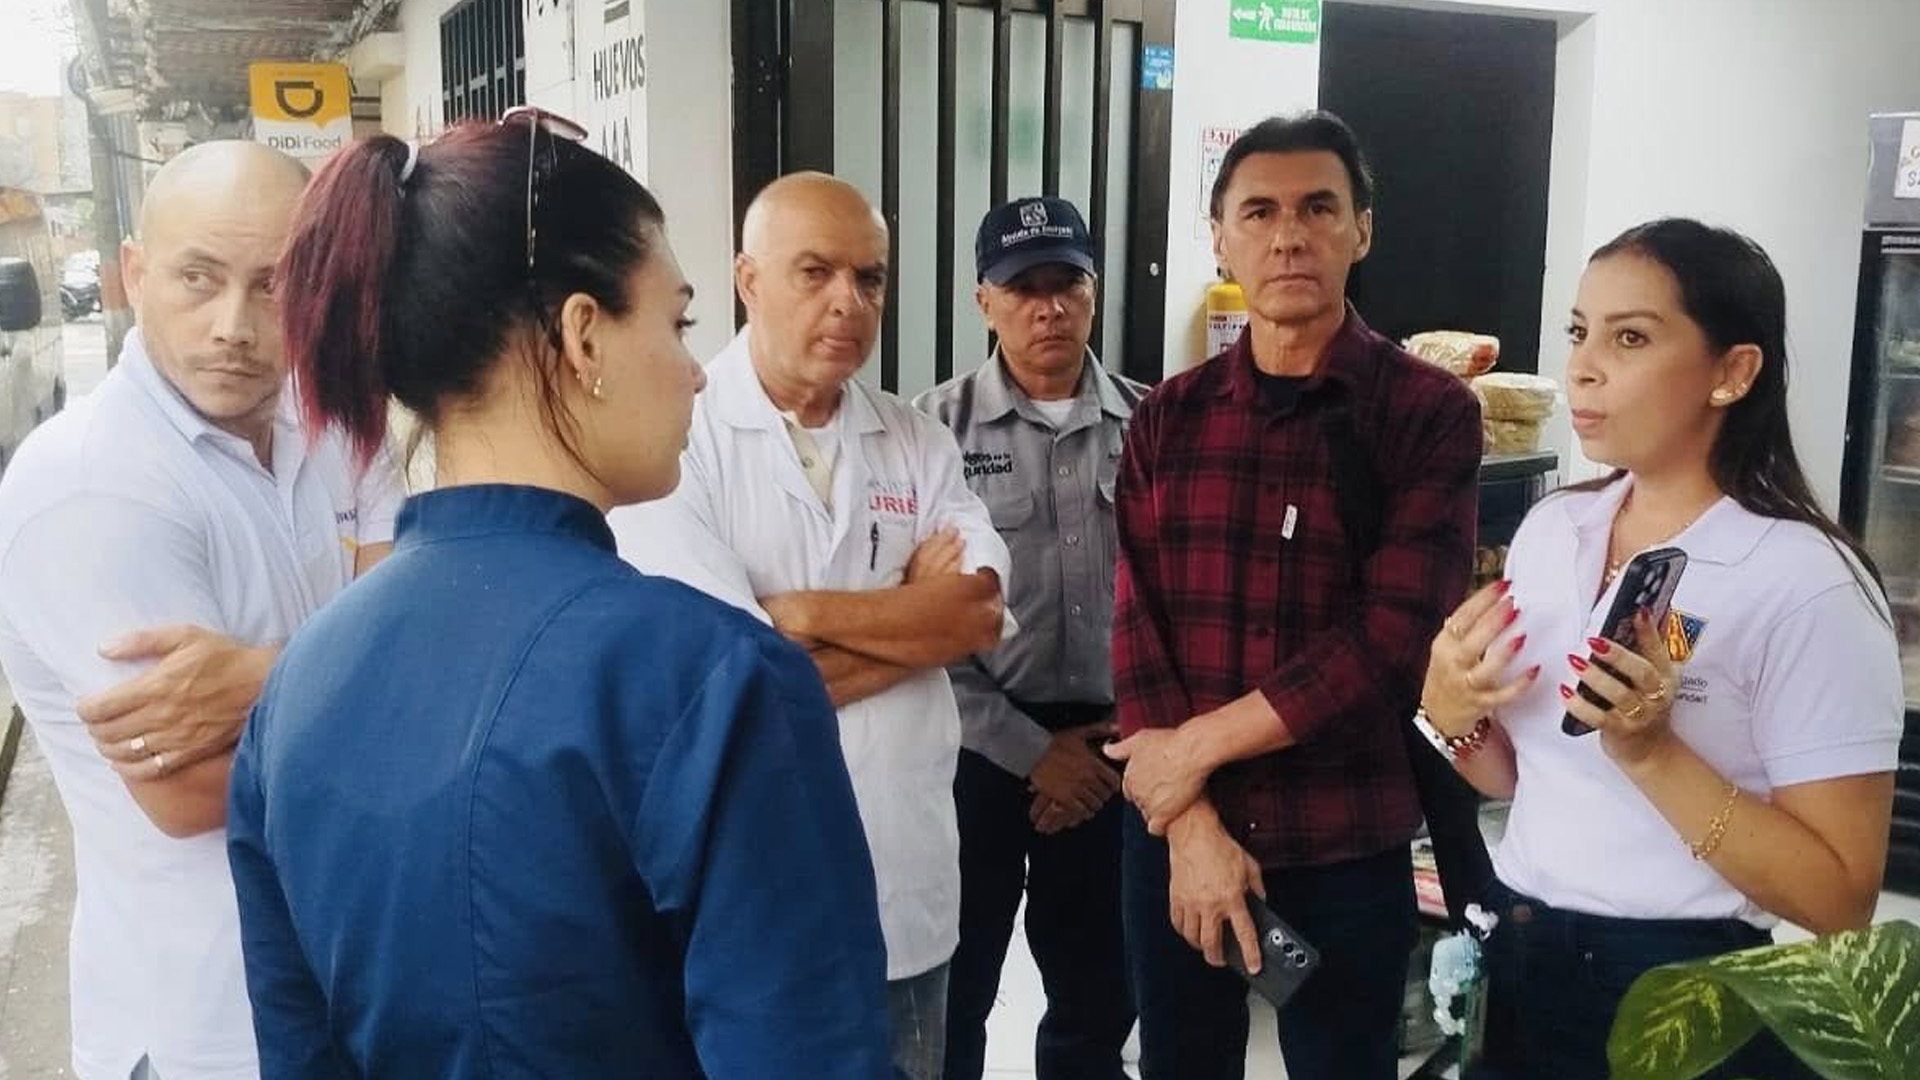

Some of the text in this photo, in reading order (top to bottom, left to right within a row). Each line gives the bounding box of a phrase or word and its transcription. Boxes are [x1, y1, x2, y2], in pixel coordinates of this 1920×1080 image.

[593, 35, 645, 101] HUEVOS
[267, 135, 341, 150] DiDi Food
